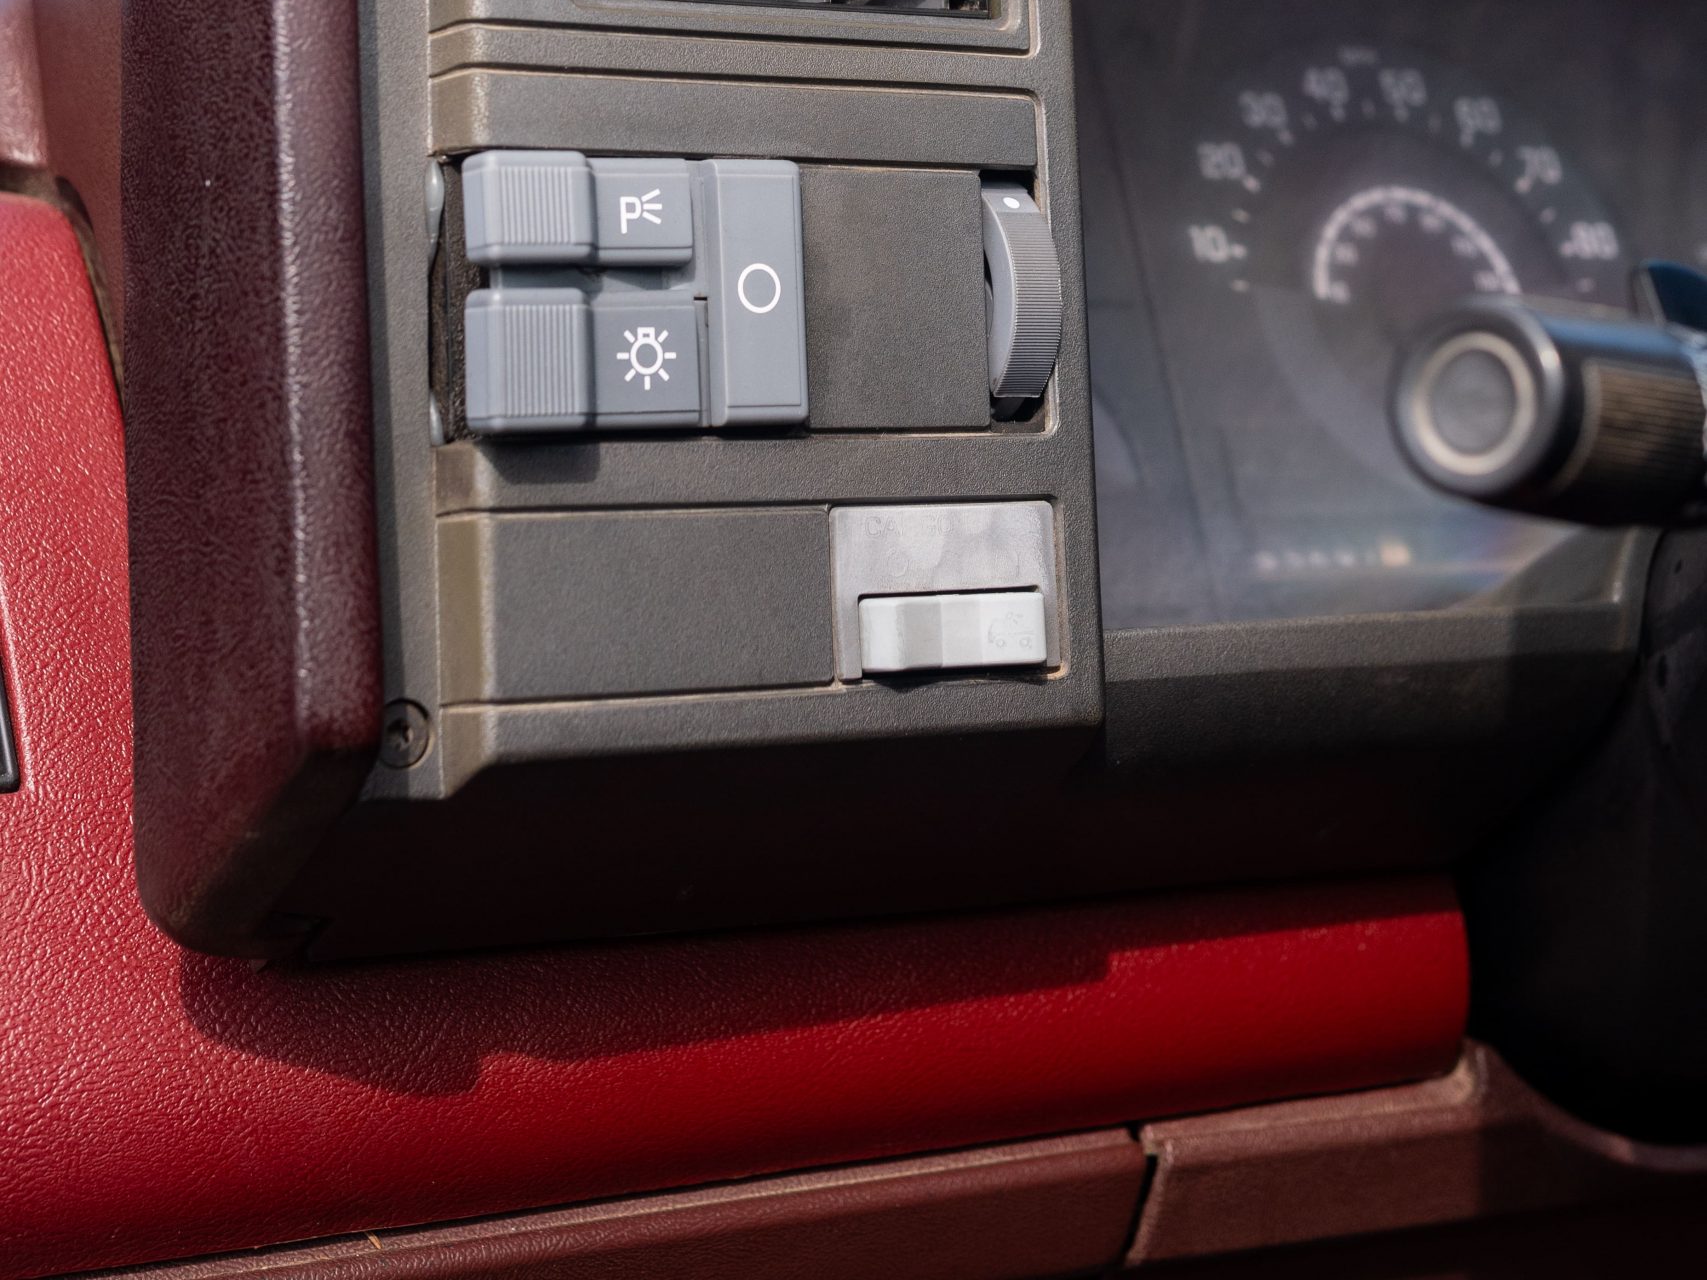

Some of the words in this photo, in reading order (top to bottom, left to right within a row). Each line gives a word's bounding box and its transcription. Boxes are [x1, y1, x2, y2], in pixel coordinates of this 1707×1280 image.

[1303, 67, 1348, 103] 40
[1378, 69, 1426, 105] 50
[1239, 90, 1289, 129] 30
[1197, 142, 1246, 179] 20
[1517, 147, 1562, 183] 70
[1188, 225, 1229, 263] 10
